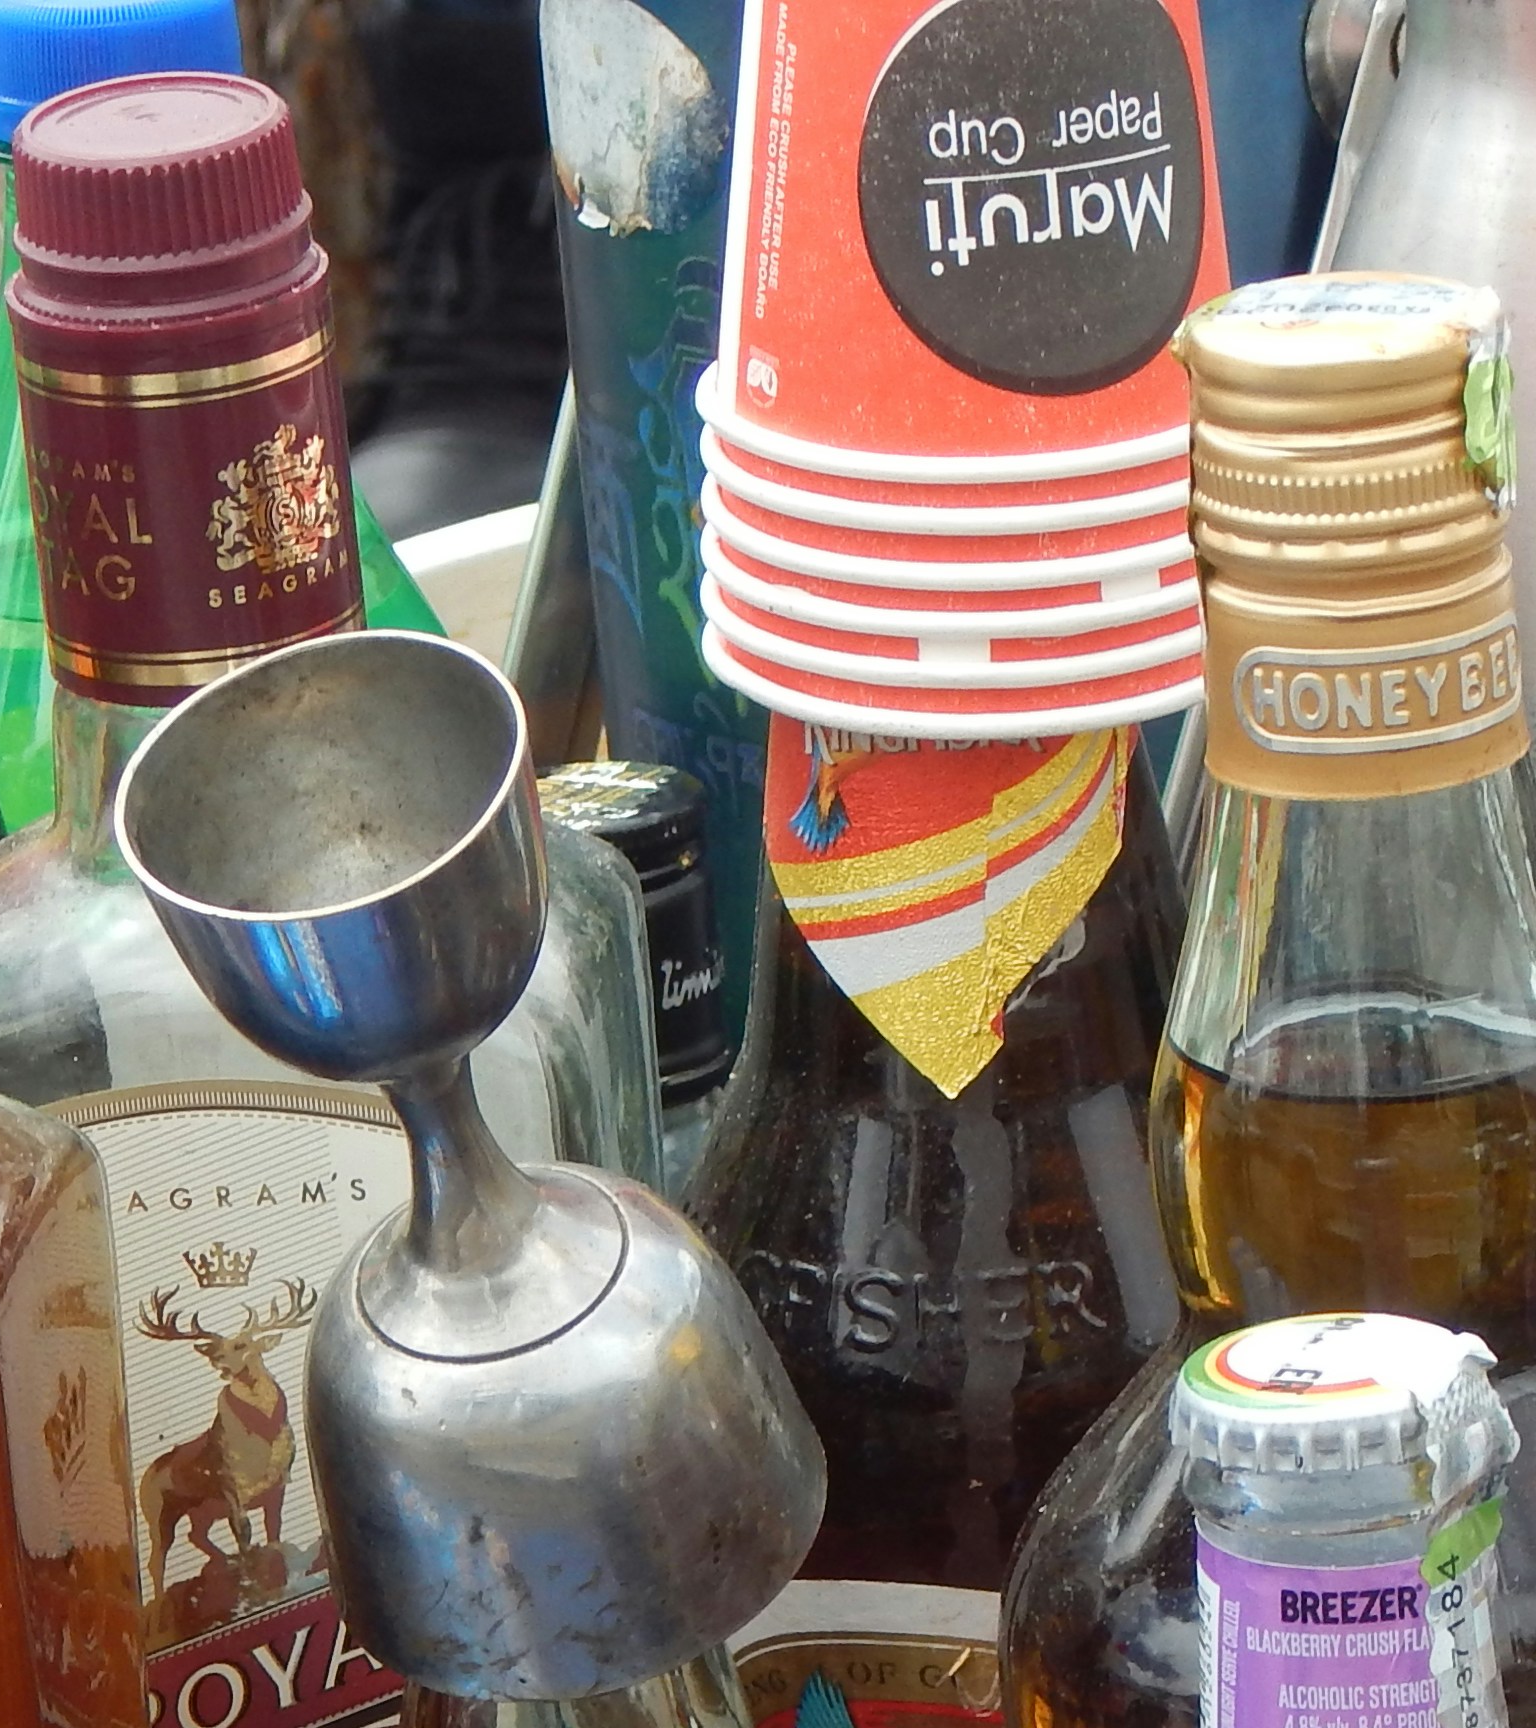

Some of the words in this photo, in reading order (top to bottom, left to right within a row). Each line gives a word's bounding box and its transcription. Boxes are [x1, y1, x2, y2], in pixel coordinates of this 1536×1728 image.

[775, 2, 788, 55] MADE
[771, 60, 784, 114] FROM
[782, 42, 797, 117] PLEASE
[768, 117, 779, 159] ECO
[929, 114, 1025, 160] Cup
[1054, 90, 1164, 146] Paper
[776, 120, 791, 184] CRUSH
[760, 160, 776, 250] FRIENDLY
[771, 185, 786, 248] AFTER
[925, 165, 1173, 276] Maruti
[755, 252, 769, 319] BOARD
[768, 251, 780, 290] USE
[1252, 660, 1448, 730] HONEY
[1280, 1585, 1421, 1625] BREEZER
[1246, 1627, 1341, 1657] BLACKBERRY
[1346, 1632, 1400, 1657] CRUSH
[1278, 1685, 1364, 1710] ALCOHOLIC
